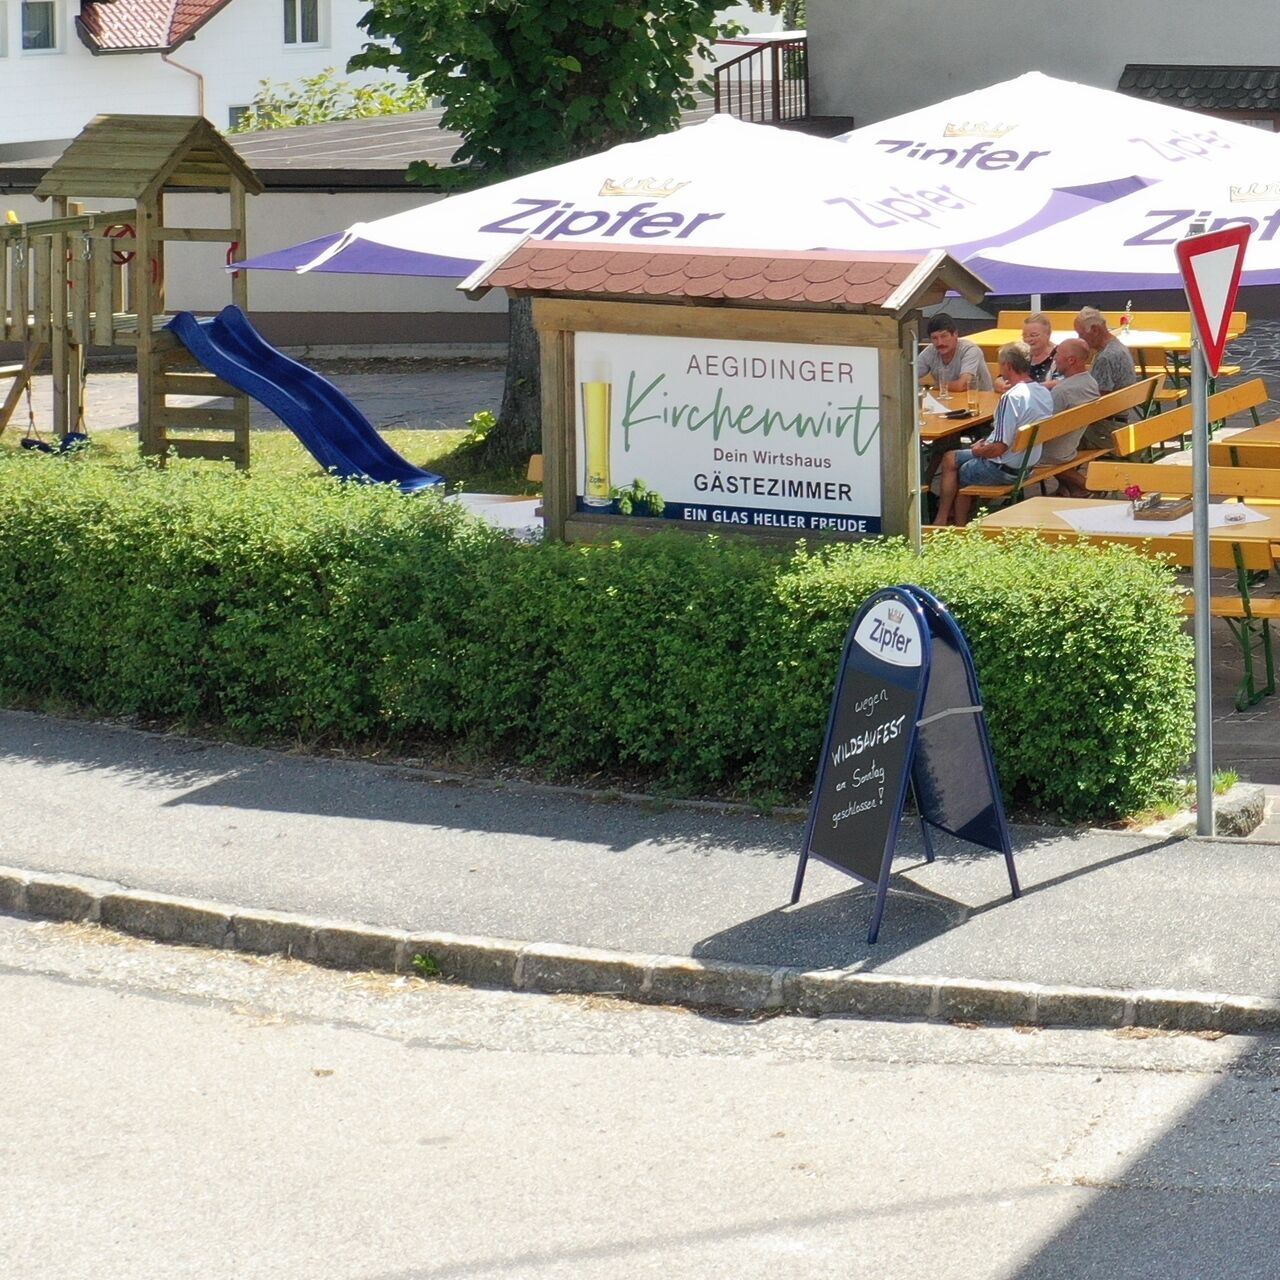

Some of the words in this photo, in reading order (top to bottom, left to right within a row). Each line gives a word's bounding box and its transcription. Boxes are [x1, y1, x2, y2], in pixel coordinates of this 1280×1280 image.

[478, 197, 726, 241] Zipfer
[686, 354, 854, 384] AEGIDINGER
[621, 370, 882, 457] Kirchenwirt
[713, 448, 749, 463] Dein
[752, 450, 832, 469] Wirtshaus
[693, 471, 853, 502] GÄSTEZIMMER
[684, 508, 707, 521] EIN
[712, 510, 749, 525] GLAS
[753, 513, 805, 529] HELLER
[810, 517, 867, 533] FREUDE
[869, 618, 912, 654] Zipfer
[855, 689, 889, 717] wegen
[831, 714, 906, 767] WILDSAUFEST
[851, 759, 885, 788] Sonntag
